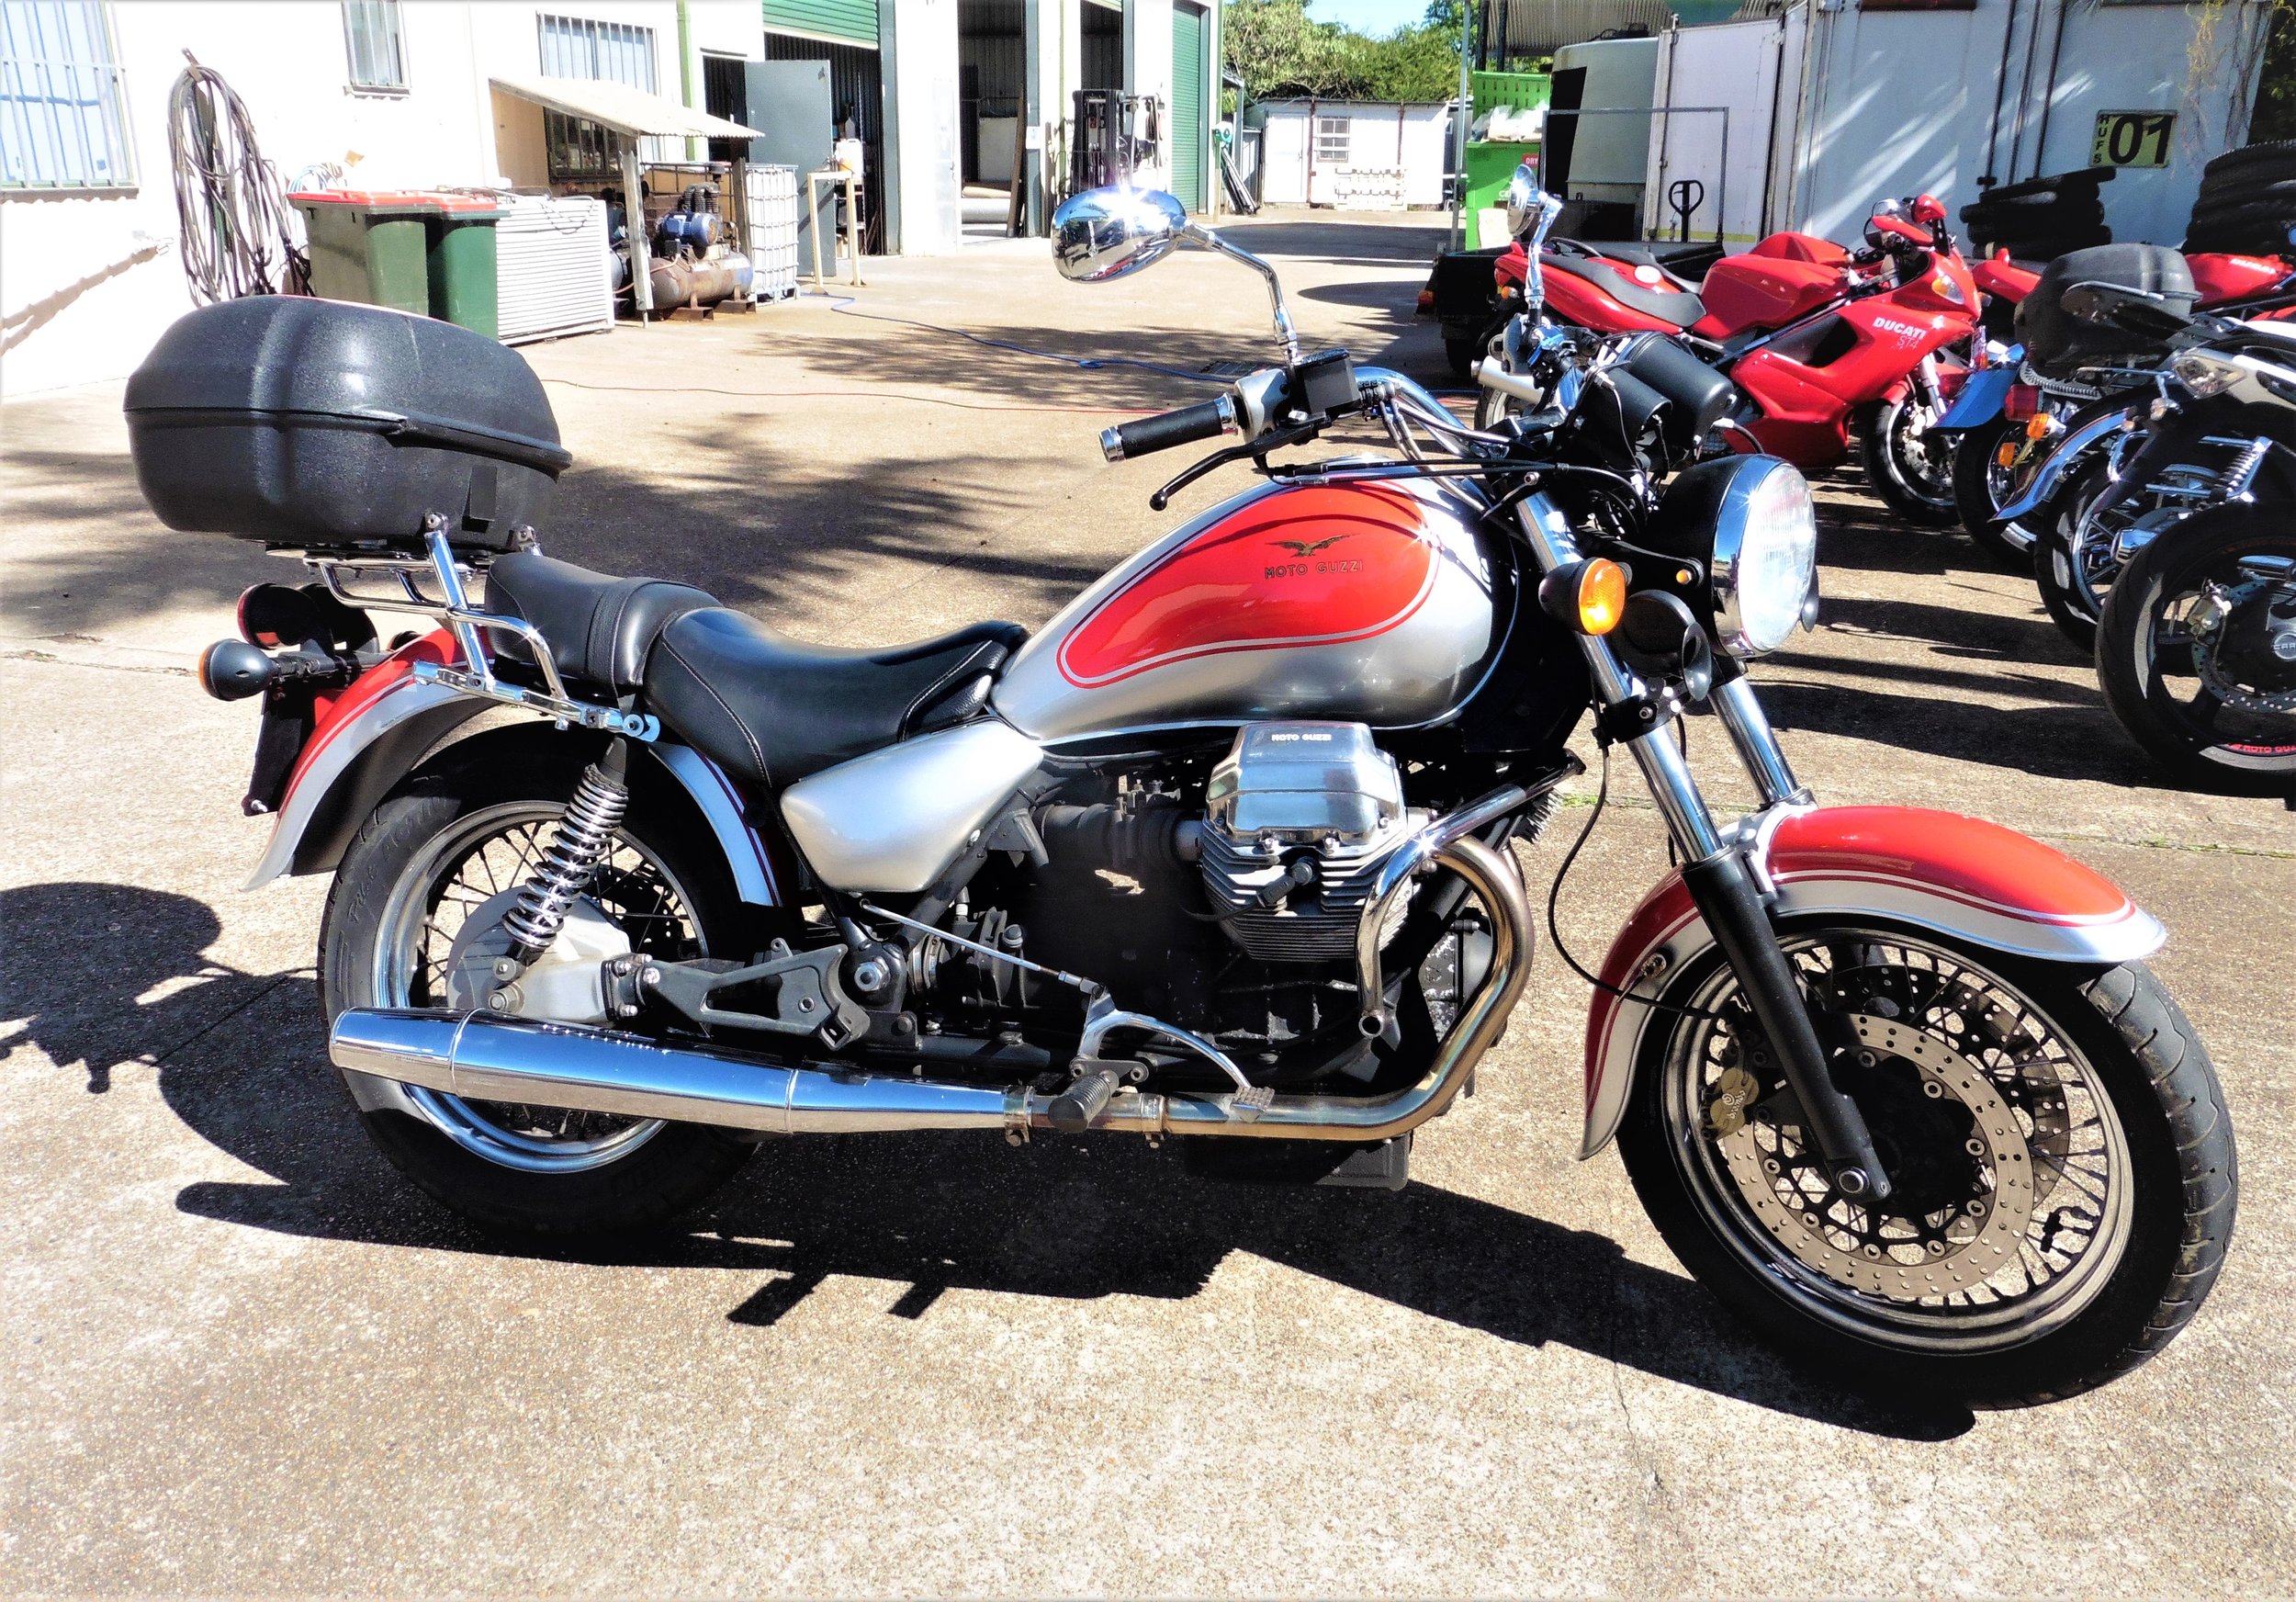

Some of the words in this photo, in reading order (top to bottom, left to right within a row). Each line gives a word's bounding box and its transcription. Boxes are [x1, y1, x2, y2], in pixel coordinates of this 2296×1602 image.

[2109, 114, 2174, 164] 01
[1525, 157, 1539, 165] DRY
[1872, 316, 1927, 340] DUCATI
[1264, 563, 1308, 580] MOTO
[1316, 558, 1365, 574] GUZZI
